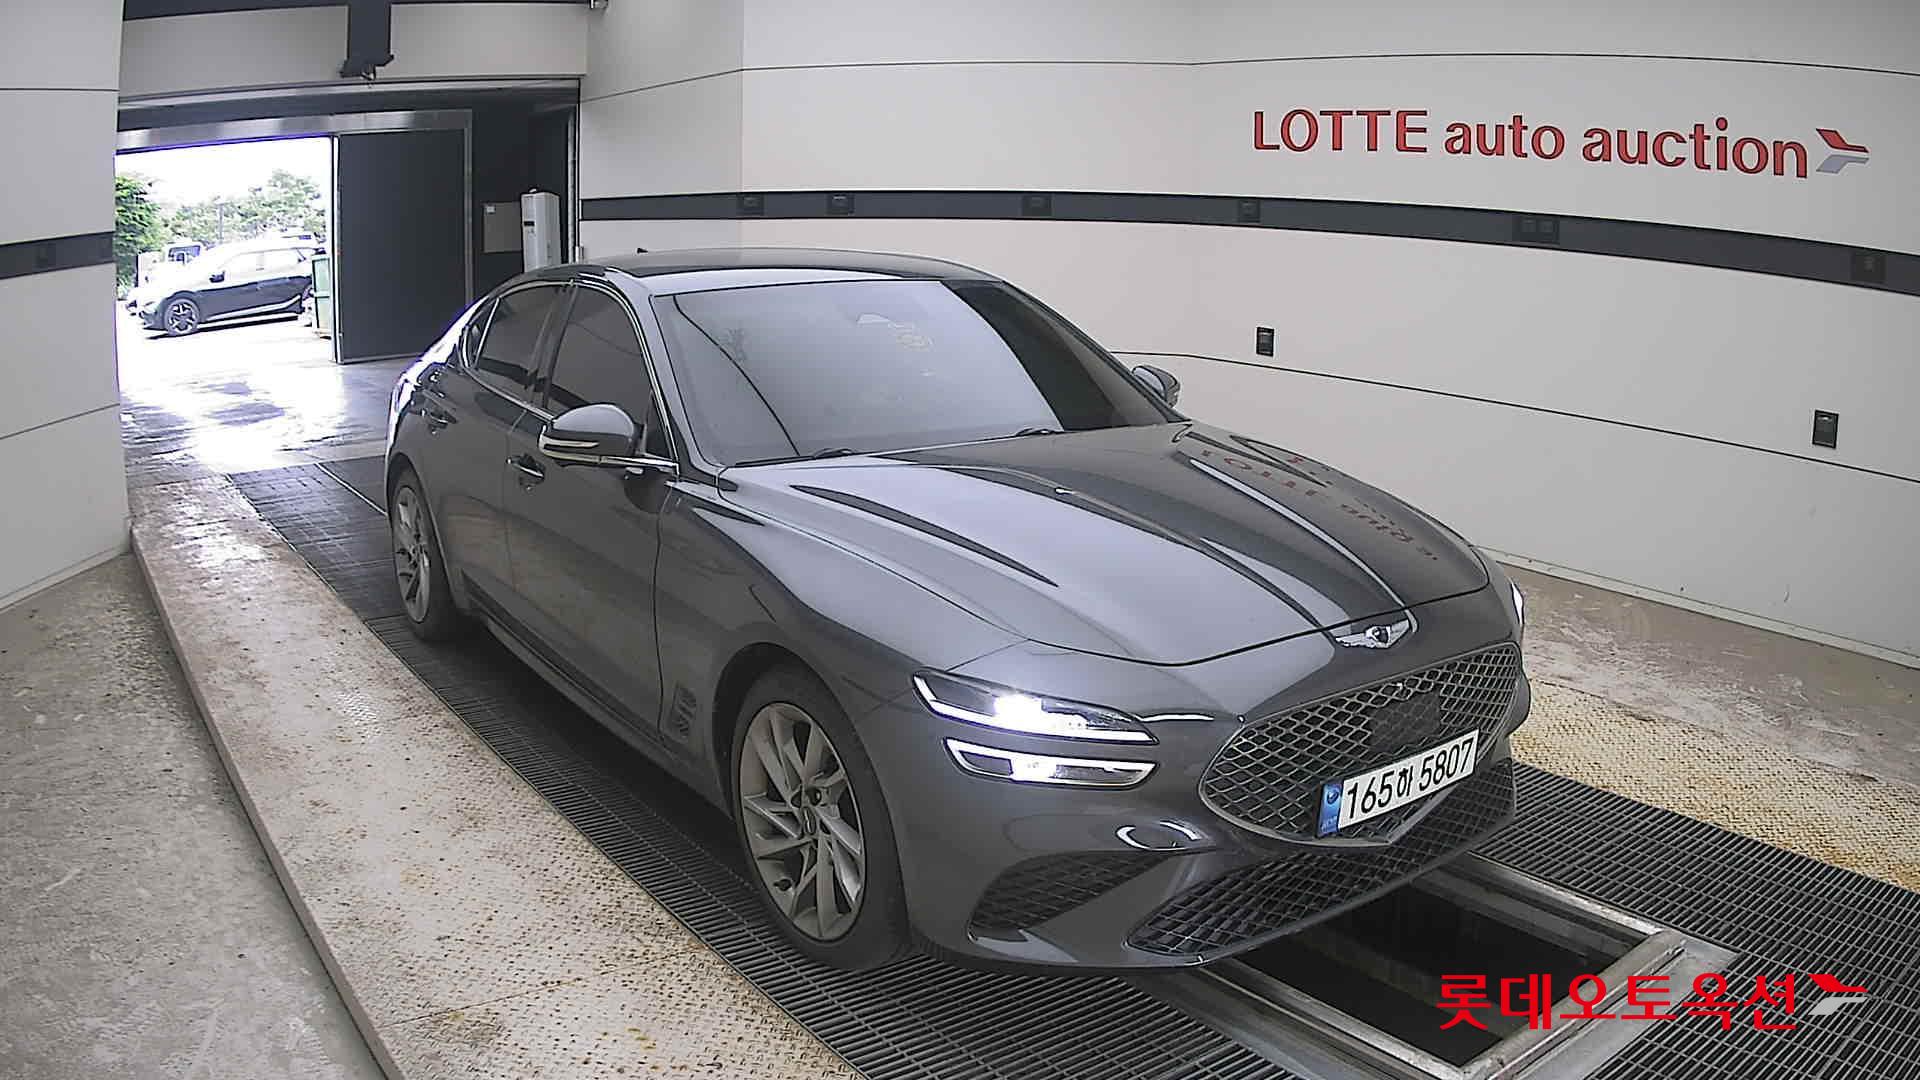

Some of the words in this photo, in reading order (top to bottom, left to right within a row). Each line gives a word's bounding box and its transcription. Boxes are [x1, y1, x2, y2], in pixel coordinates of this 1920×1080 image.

[1253, 109, 1428, 153] LOTTE
[1445, 115, 1565, 161] auto
[1583, 117, 1808, 178] auction
[1347, 766, 1413, 819] 165하
[1419, 737, 1475, 791] 5807
